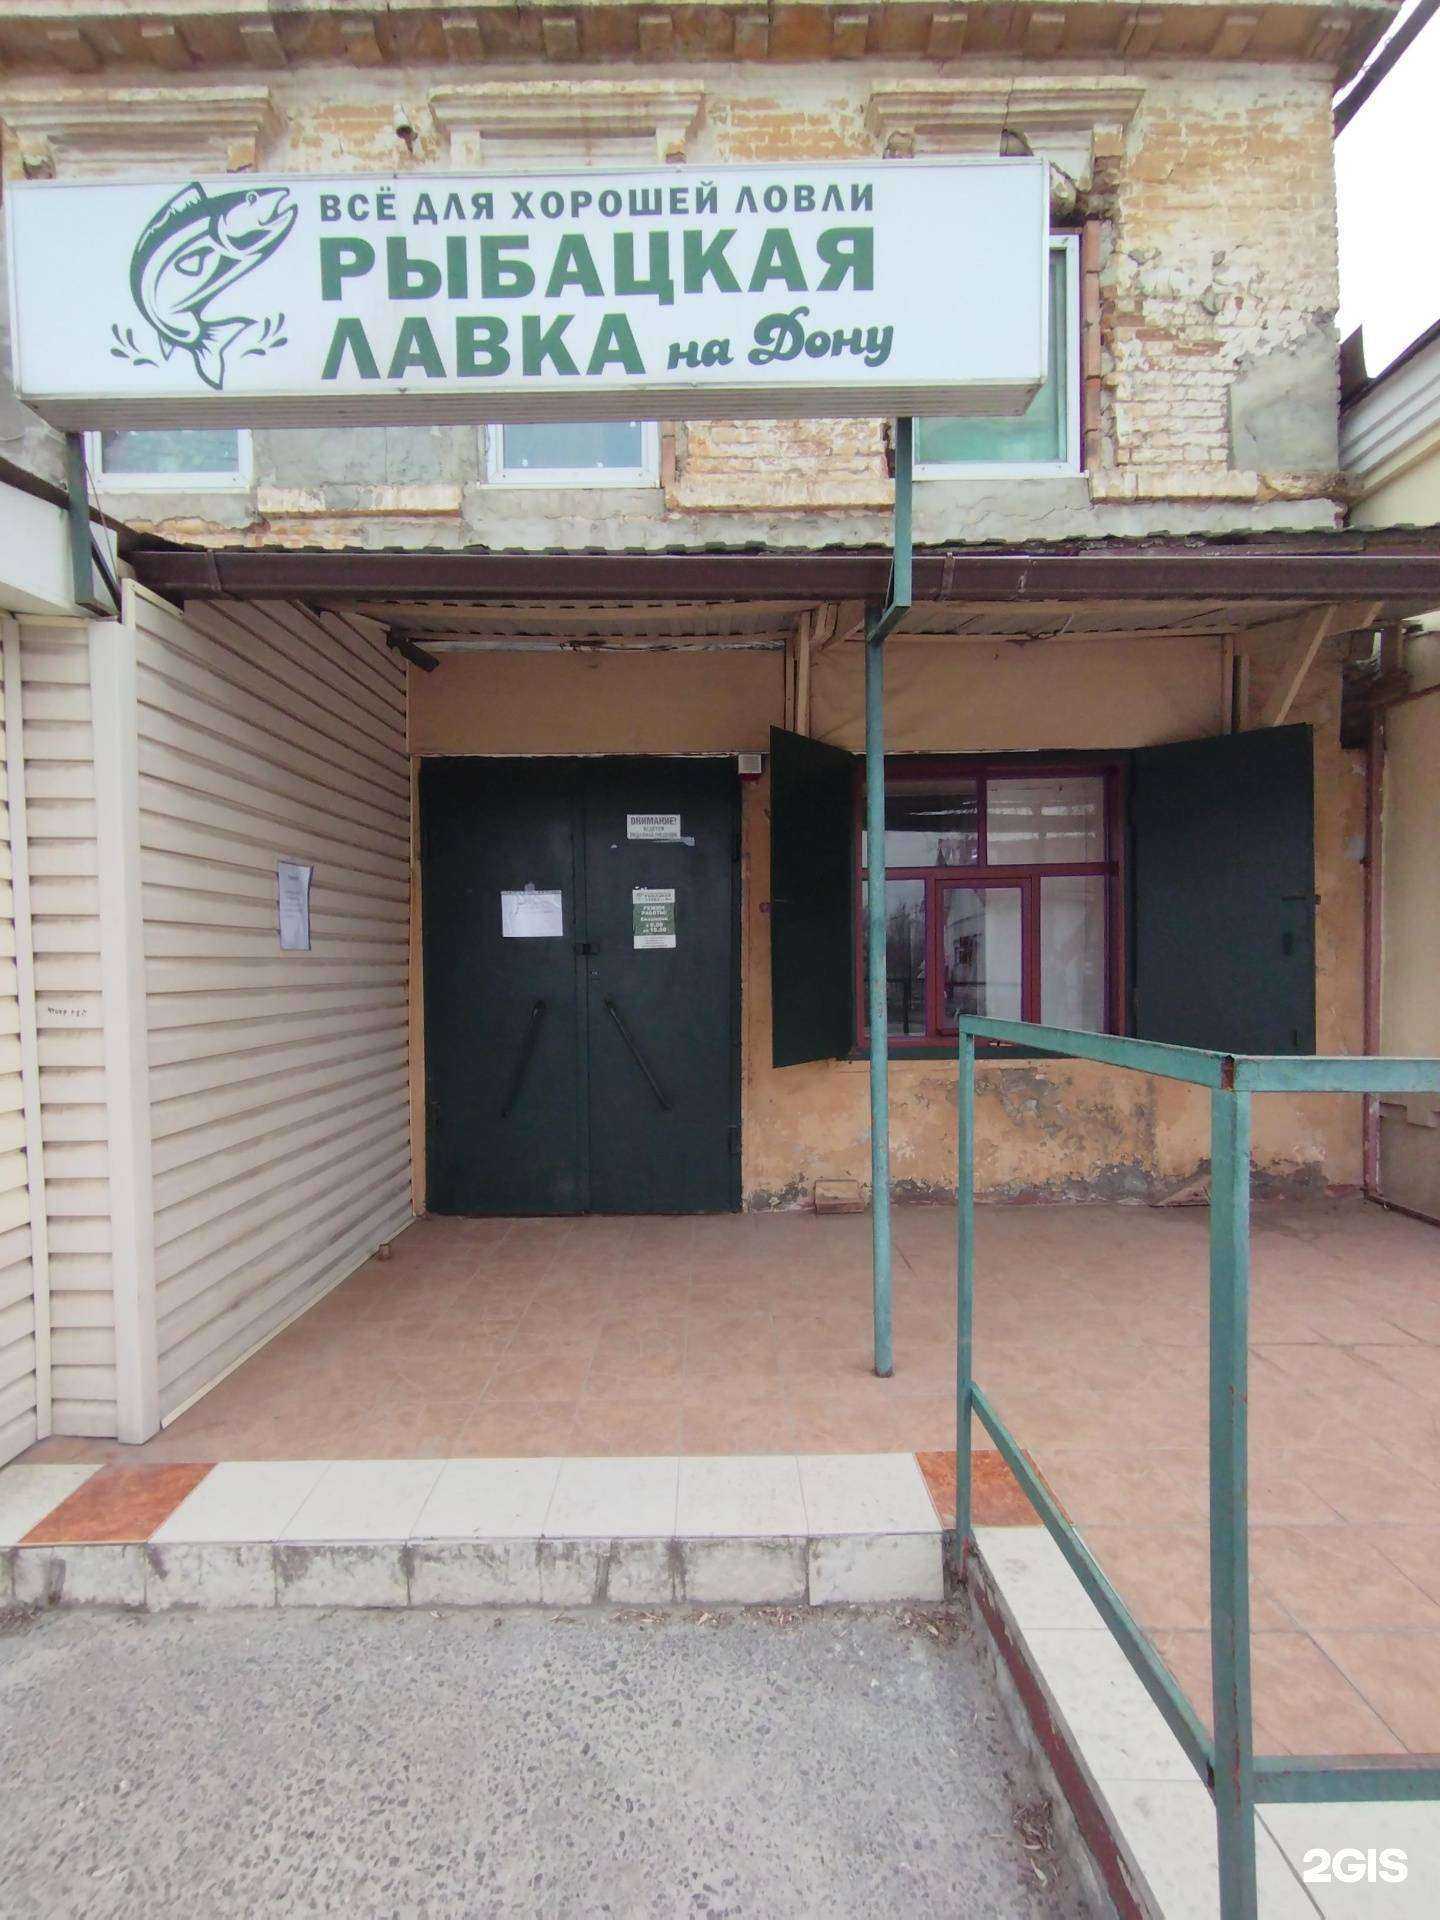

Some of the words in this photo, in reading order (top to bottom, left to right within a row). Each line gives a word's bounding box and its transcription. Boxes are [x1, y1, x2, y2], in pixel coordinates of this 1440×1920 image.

[320, 186, 396, 222] ВСЁ
[413, 192, 494, 225] ДЛЯ
[511, 181, 718, 219] ХОРОШЕЙ
[735, 183, 873, 213] ЛОВЛИ
[319, 226, 874, 305] РЫБАЦКАЯ
[321, 313, 646, 379] ЛАВКА
[667, 338, 734, 370] на
[748, 306, 894, 368] Дону
